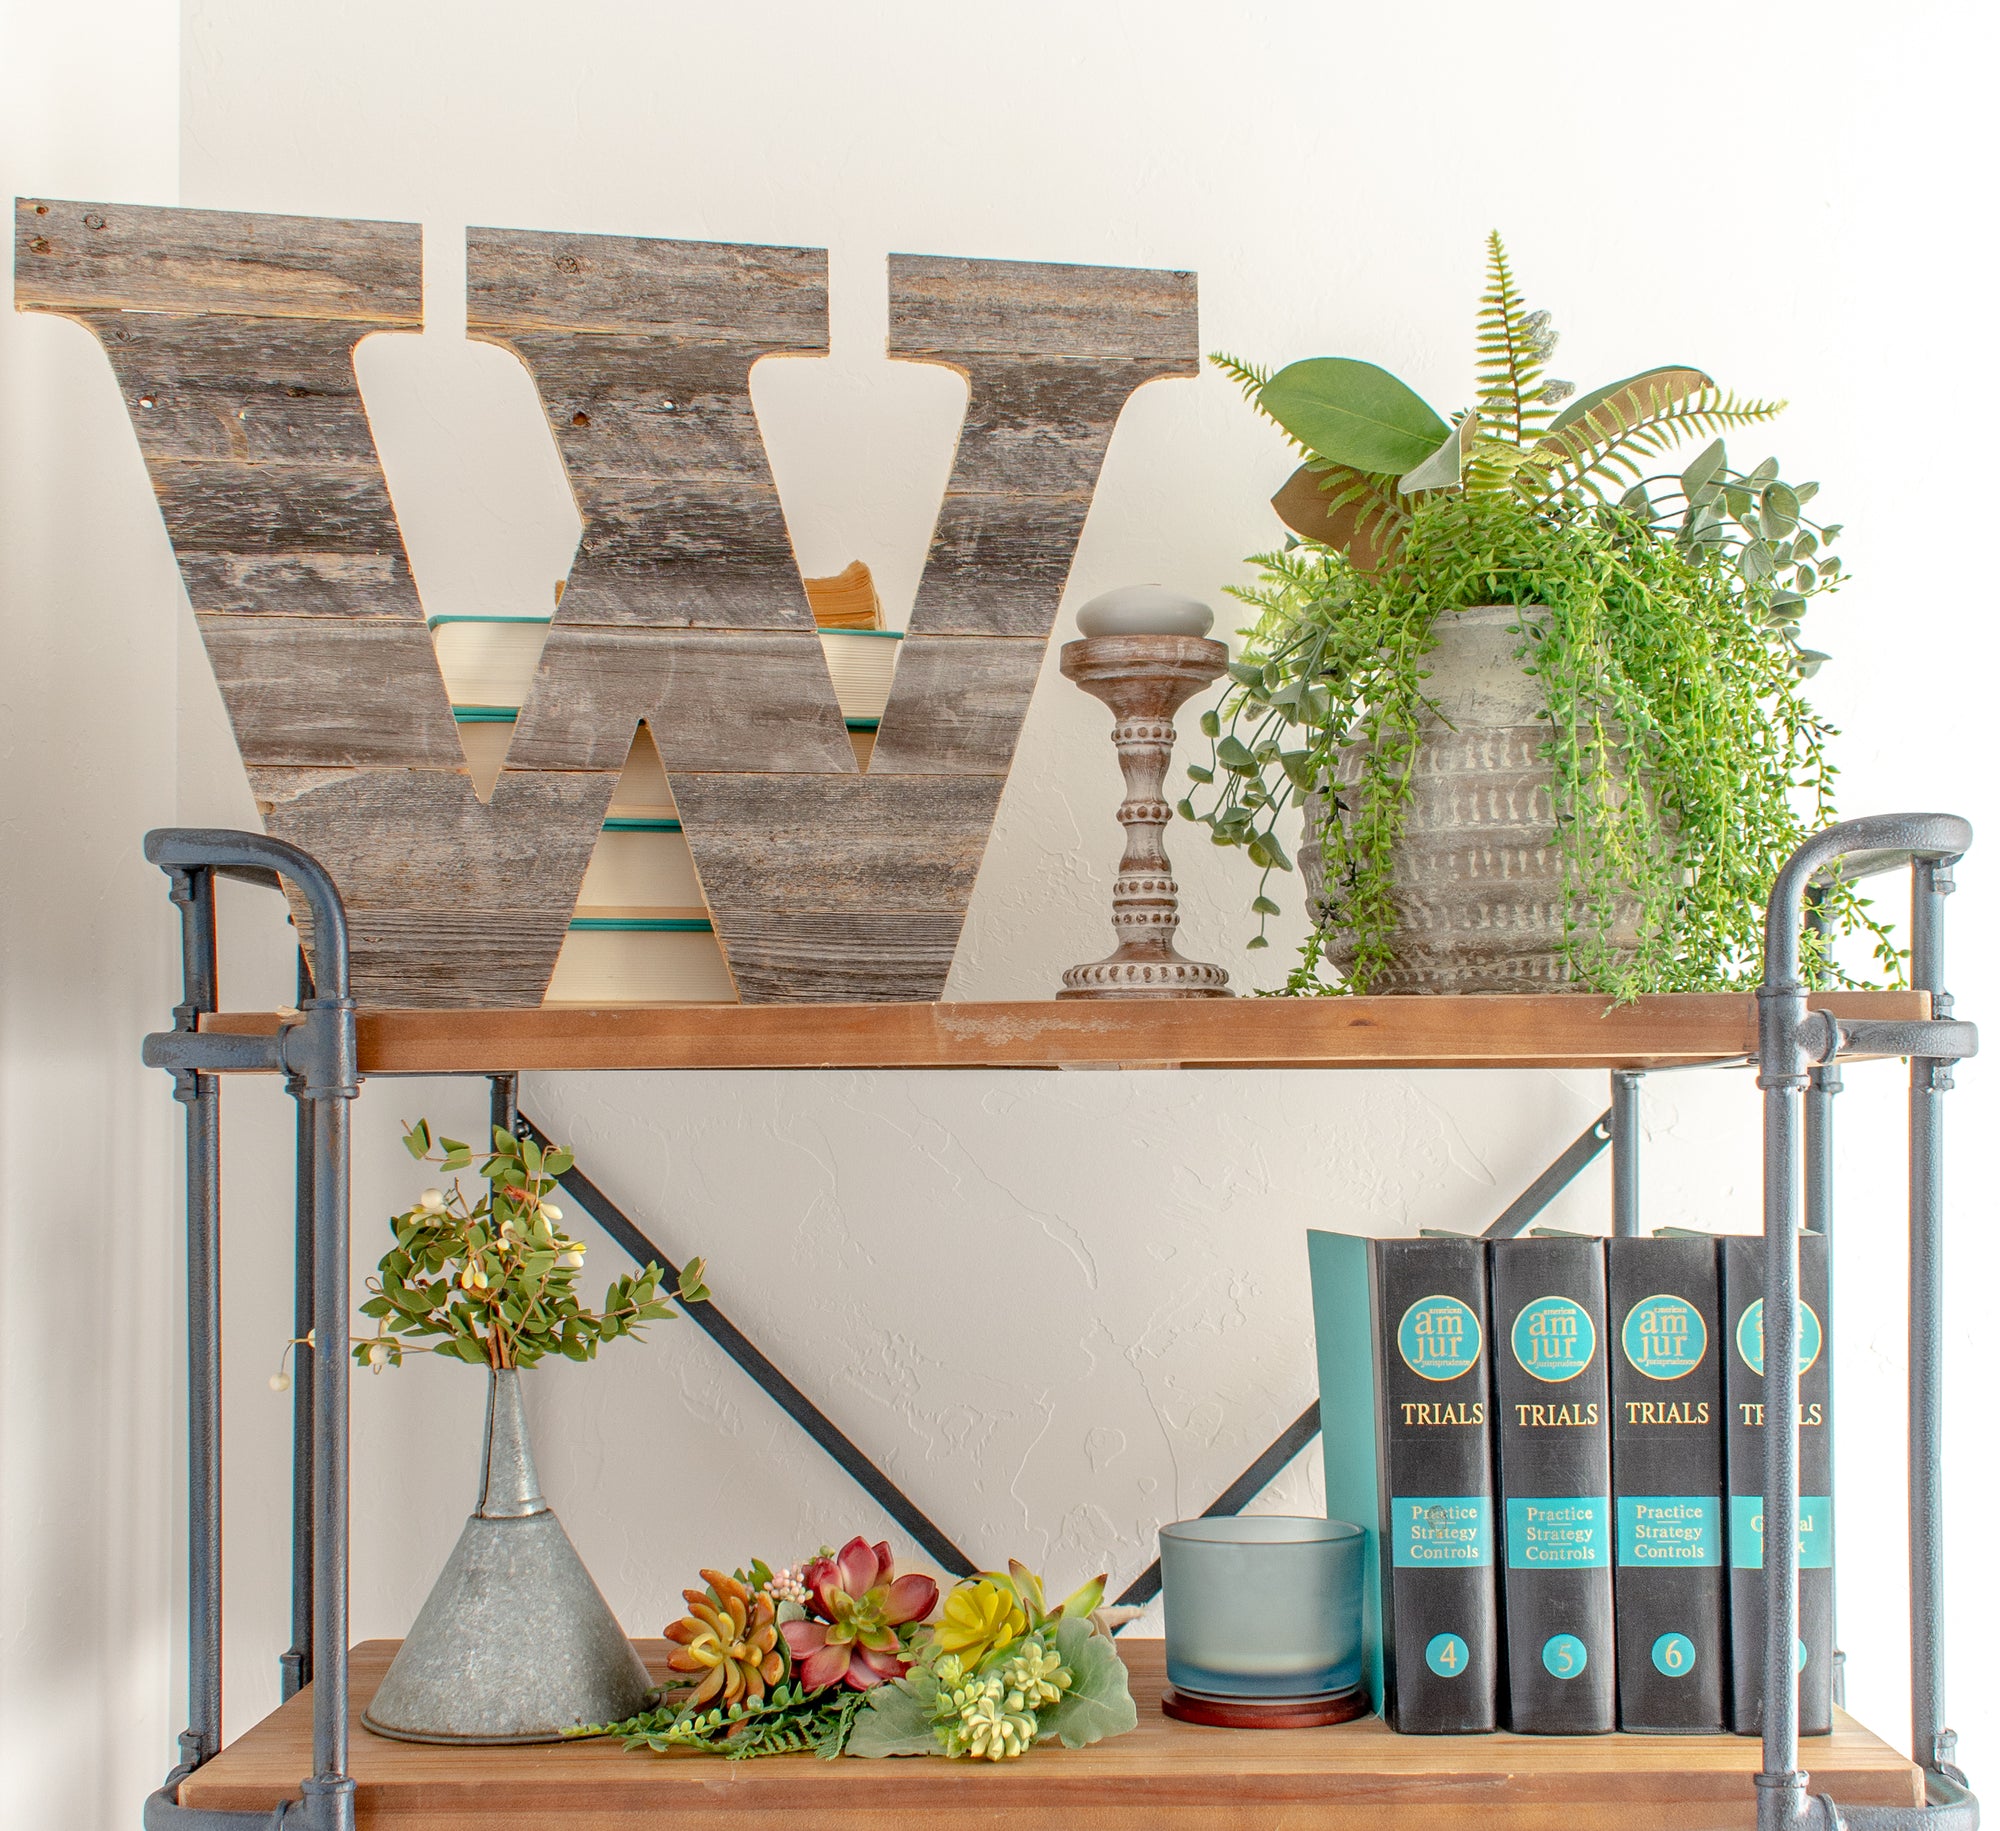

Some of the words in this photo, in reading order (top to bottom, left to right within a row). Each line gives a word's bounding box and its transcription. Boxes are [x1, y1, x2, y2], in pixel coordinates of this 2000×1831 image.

[15, 197, 1199, 1007] W
[1429, 1306, 1462, 1314] american
[1543, 1307, 1577, 1315] american
[1415, 1311, 1463, 1335] am
[1529, 1312, 1577, 1336] am
[1639, 1310, 1688, 1334] am
[1413, 1336, 1462, 1363] jur
[1527, 1337, 1577, 1365] jur
[1637, 1335, 1687, 1362] jur
[1421, 1359, 1471, 1368] jurisprudence
[1535, 1360, 1585, 1369] jurisprudence
[1401, 1402, 1485, 1425] TRIALS
[1515, 1403, 1599, 1426] TRIALS
[1625, 1402, 1710, 1425] TRIALS
[1527, 1507, 1593, 1521] Practice
[1636, 1505, 1703, 1519] Practice
[1527, 1527, 1593, 1543] Strategy
[1635, 1525, 1702, 1541] Strategy
[1410, 1545, 1479, 1559] Controls
[1526, 1546, 1595, 1561] Controls
[1634, 1545, 1704, 1559] Controls
[1440, 1640, 1457, 1669] 4
[1558, 1644, 1573, 1672] 5
[1665, 1640, 1682, 1668] 6
